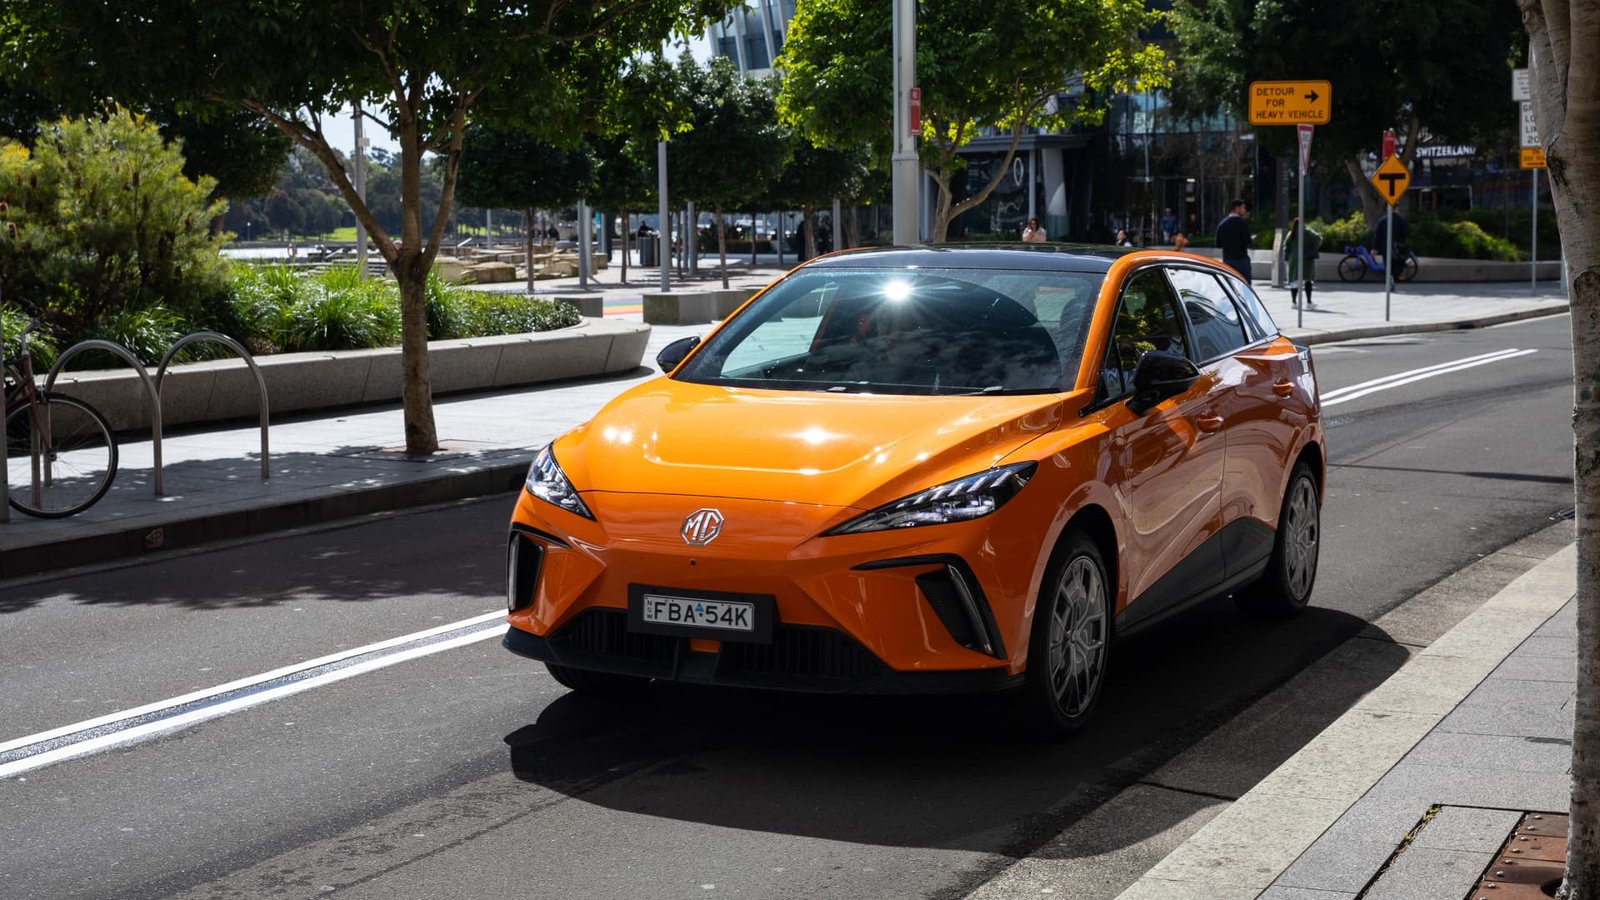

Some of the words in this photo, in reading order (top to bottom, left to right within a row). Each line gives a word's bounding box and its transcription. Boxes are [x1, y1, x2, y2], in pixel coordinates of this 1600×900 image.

[1256, 87, 1295, 97] DETOUR
[1265, 99, 1286, 108] FOR
[1256, 110, 1285, 119] HEAVY
[1288, 109, 1324, 119] VEHICLE
[684, 510, 721, 542] MG
